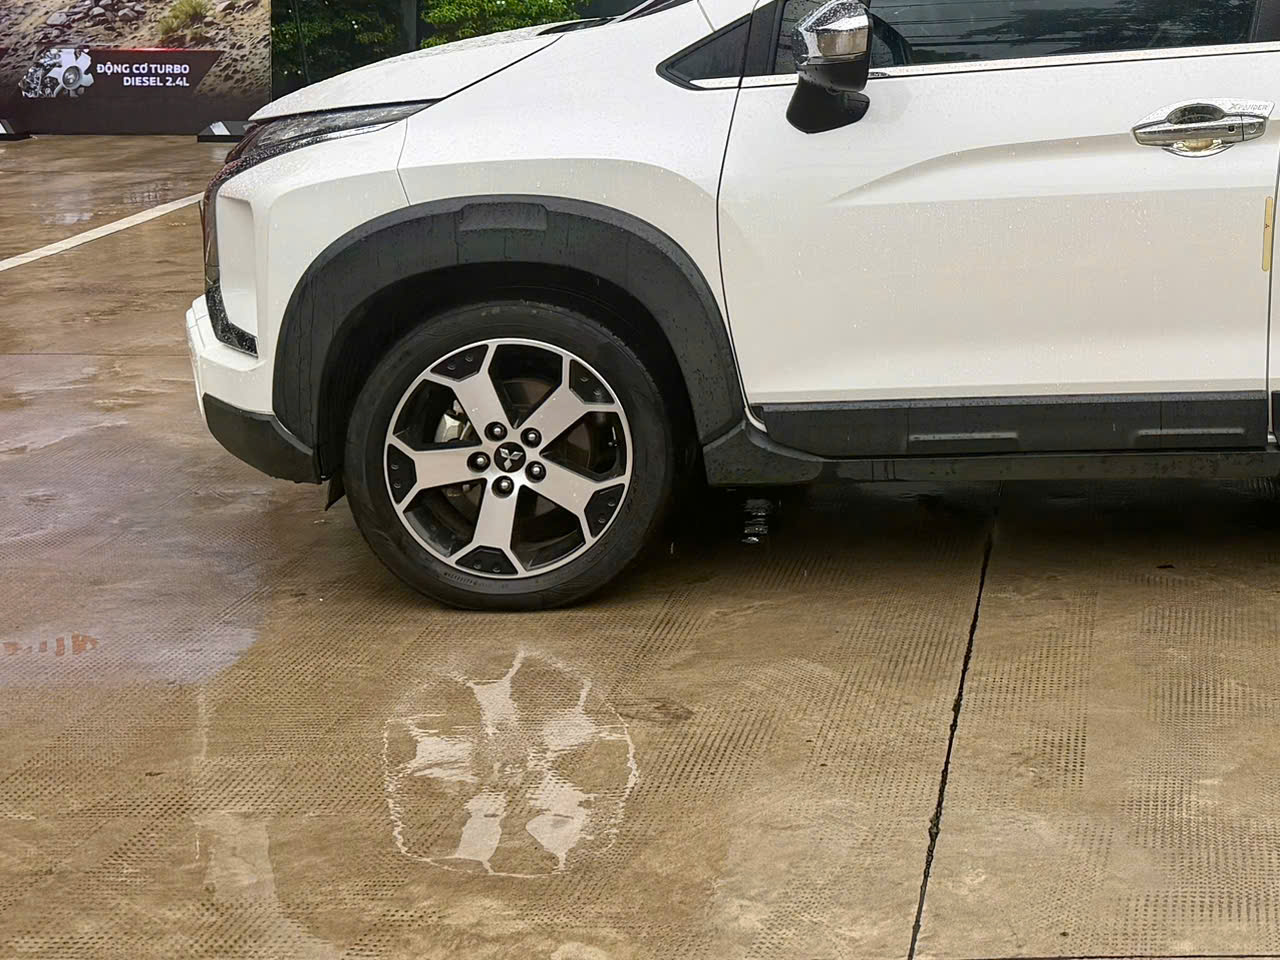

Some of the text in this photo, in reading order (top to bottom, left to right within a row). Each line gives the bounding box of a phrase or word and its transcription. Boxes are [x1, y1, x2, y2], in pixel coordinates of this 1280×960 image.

[96, 62, 190, 76] ĐỘNG CƠ TURBO
[123, 77, 190, 87] DIESEL 2.4L
